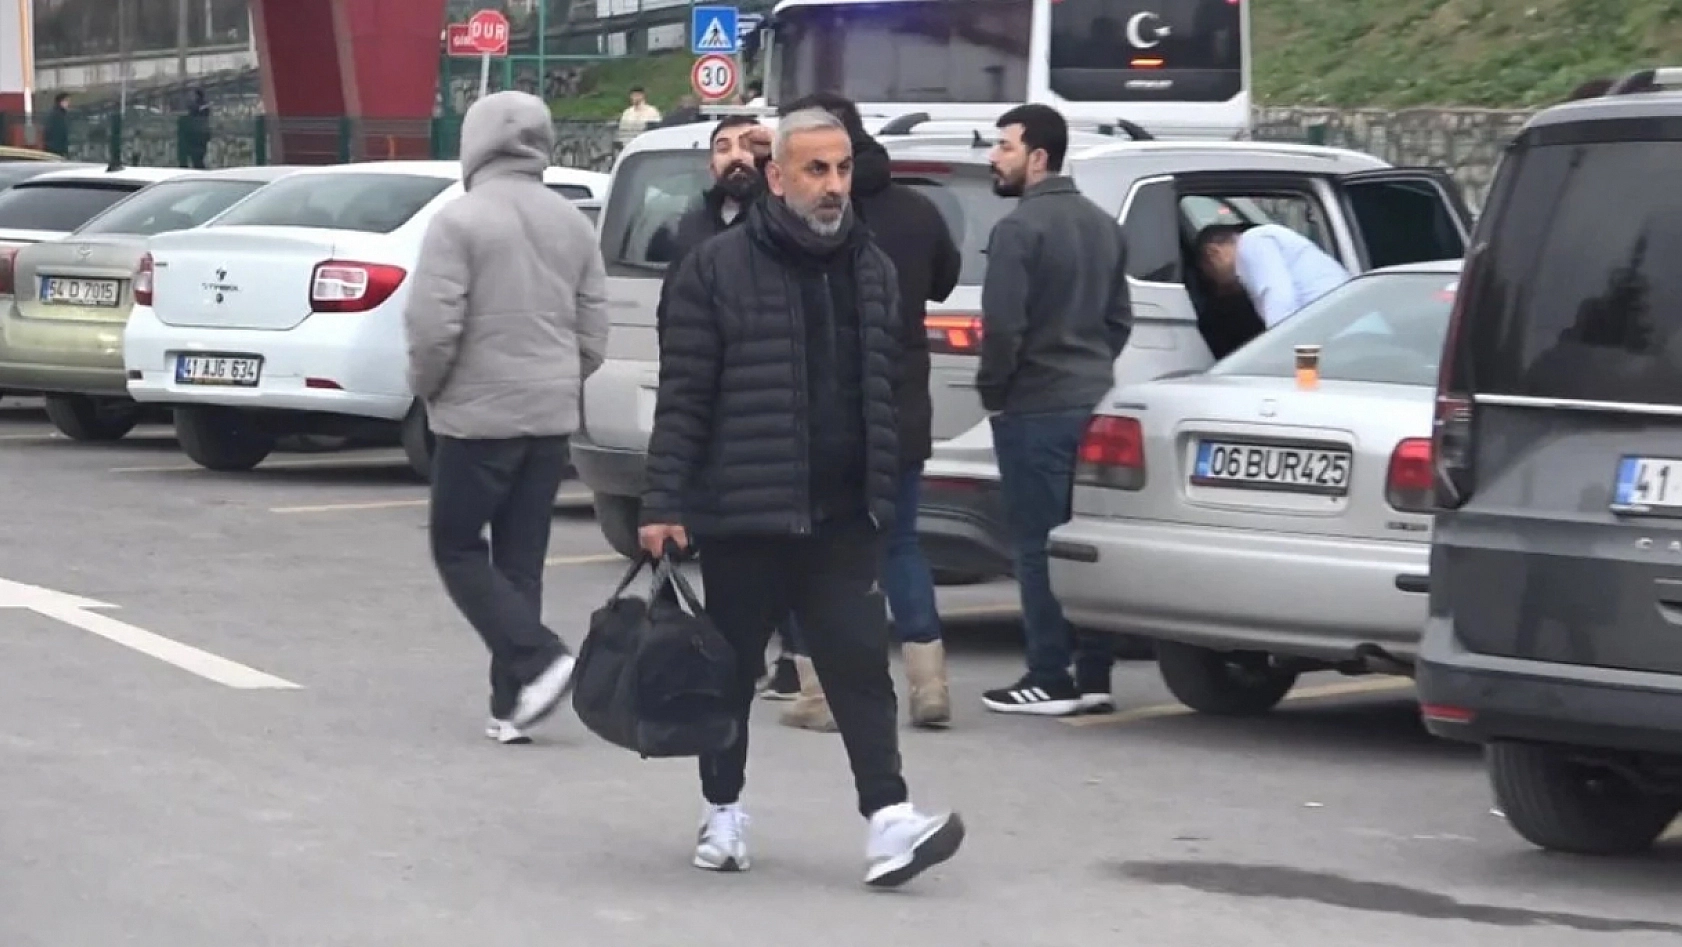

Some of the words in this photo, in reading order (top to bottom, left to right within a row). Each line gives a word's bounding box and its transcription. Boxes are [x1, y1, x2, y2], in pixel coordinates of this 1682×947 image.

[472, 21, 505, 40] DUR
[702, 65, 727, 86] 30
[50, 281, 64, 297] 54
[69, 281, 79, 297] D
[84, 282, 113, 299] 7015
[185, 358, 198, 375] 41
[202, 359, 225, 377] AJG
[231, 360, 254, 378] 634
[1635, 463, 1671, 501] 41
